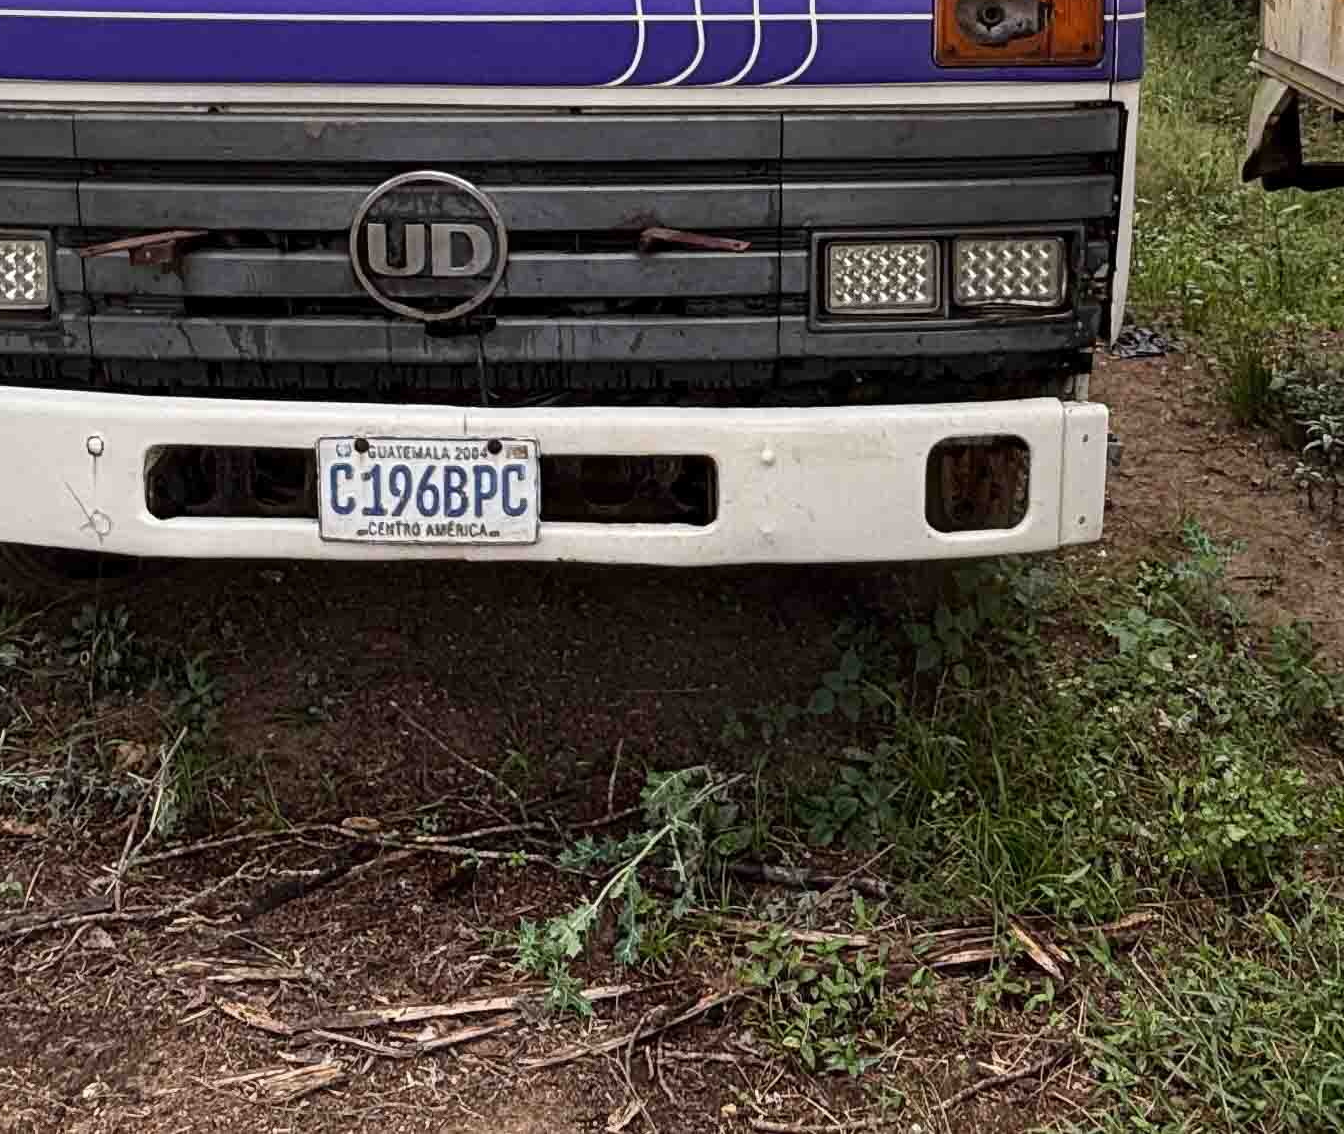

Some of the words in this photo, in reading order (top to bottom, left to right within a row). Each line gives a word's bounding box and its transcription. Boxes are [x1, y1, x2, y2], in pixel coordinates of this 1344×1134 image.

[367, 222, 493, 277] UD
[367, 445, 450, 460] GUATEMALA
[330, 462, 529, 518] C196BPC
[368, 521, 420, 537] CENTRO
